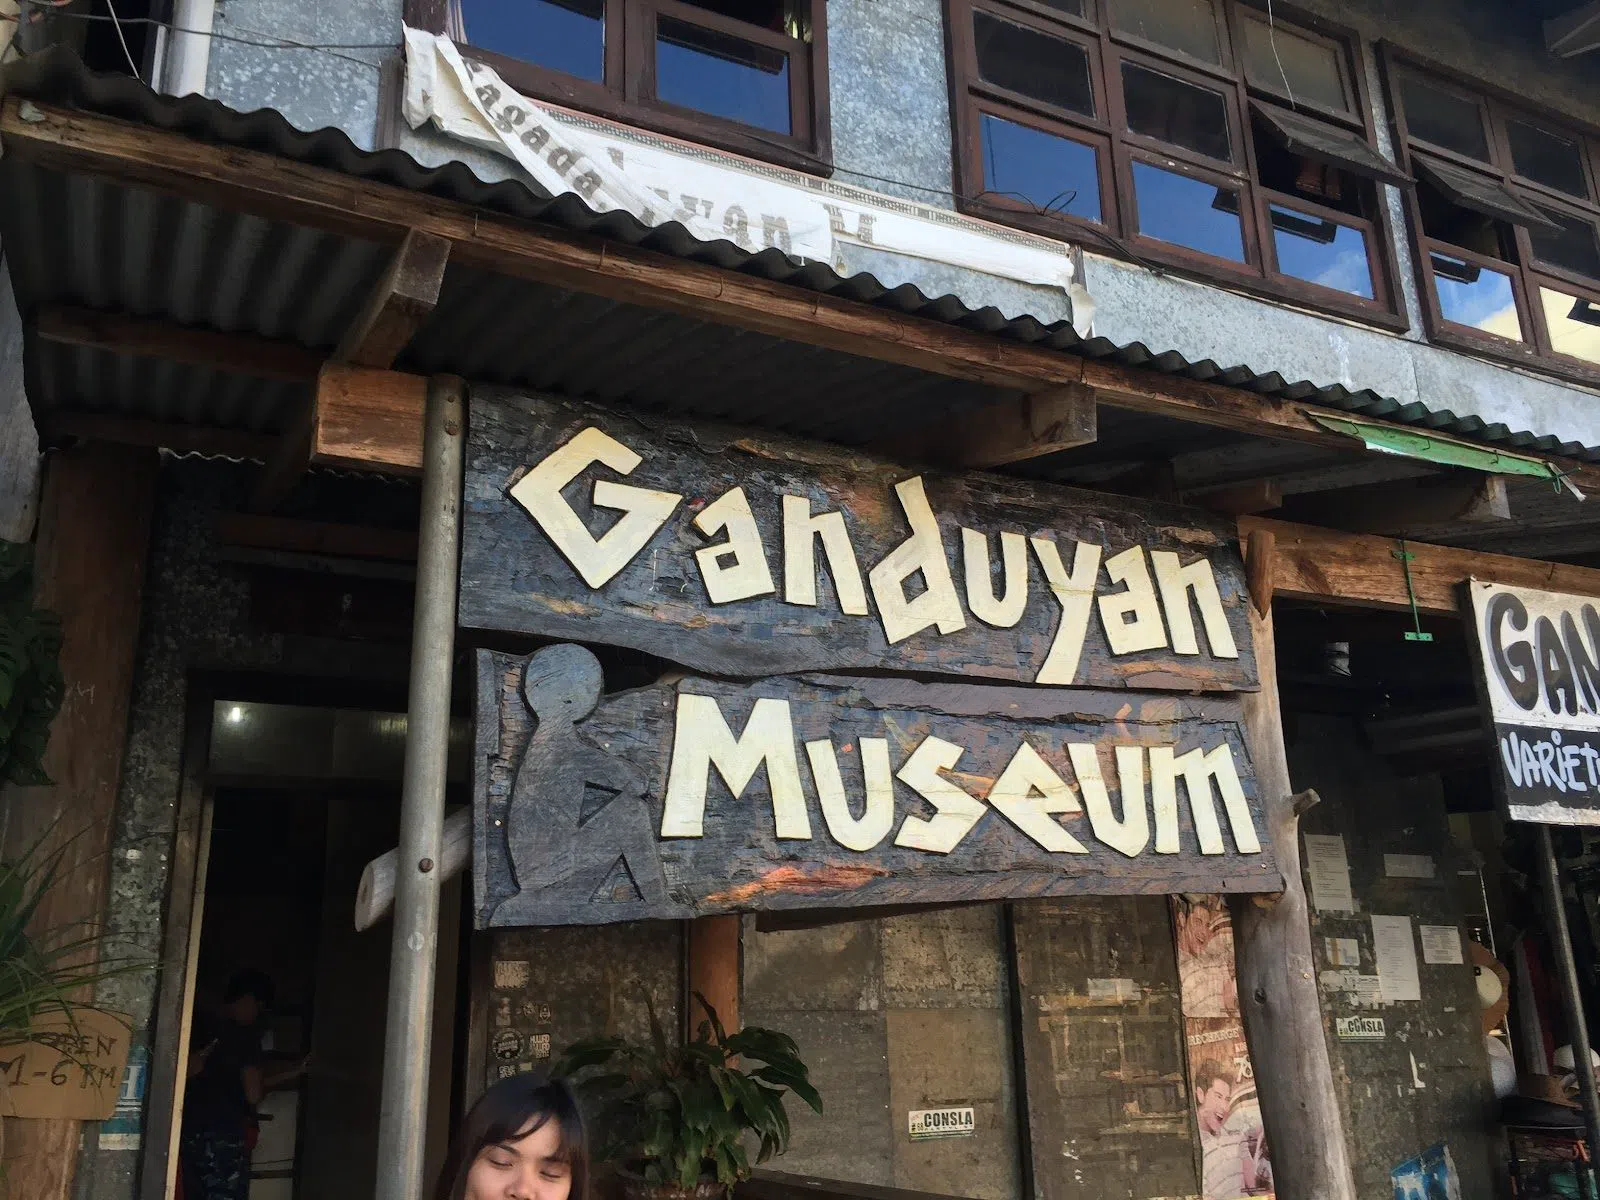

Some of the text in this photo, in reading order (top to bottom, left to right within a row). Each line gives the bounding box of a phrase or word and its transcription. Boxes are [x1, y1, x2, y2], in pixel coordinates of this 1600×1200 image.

[510, 426, 1239, 685] Ganduyan
[660, 693, 1262, 858] Museum
[1347, 1017, 1384, 1033] CONSLA
[924, 1111, 973, 1127] CONSLA
